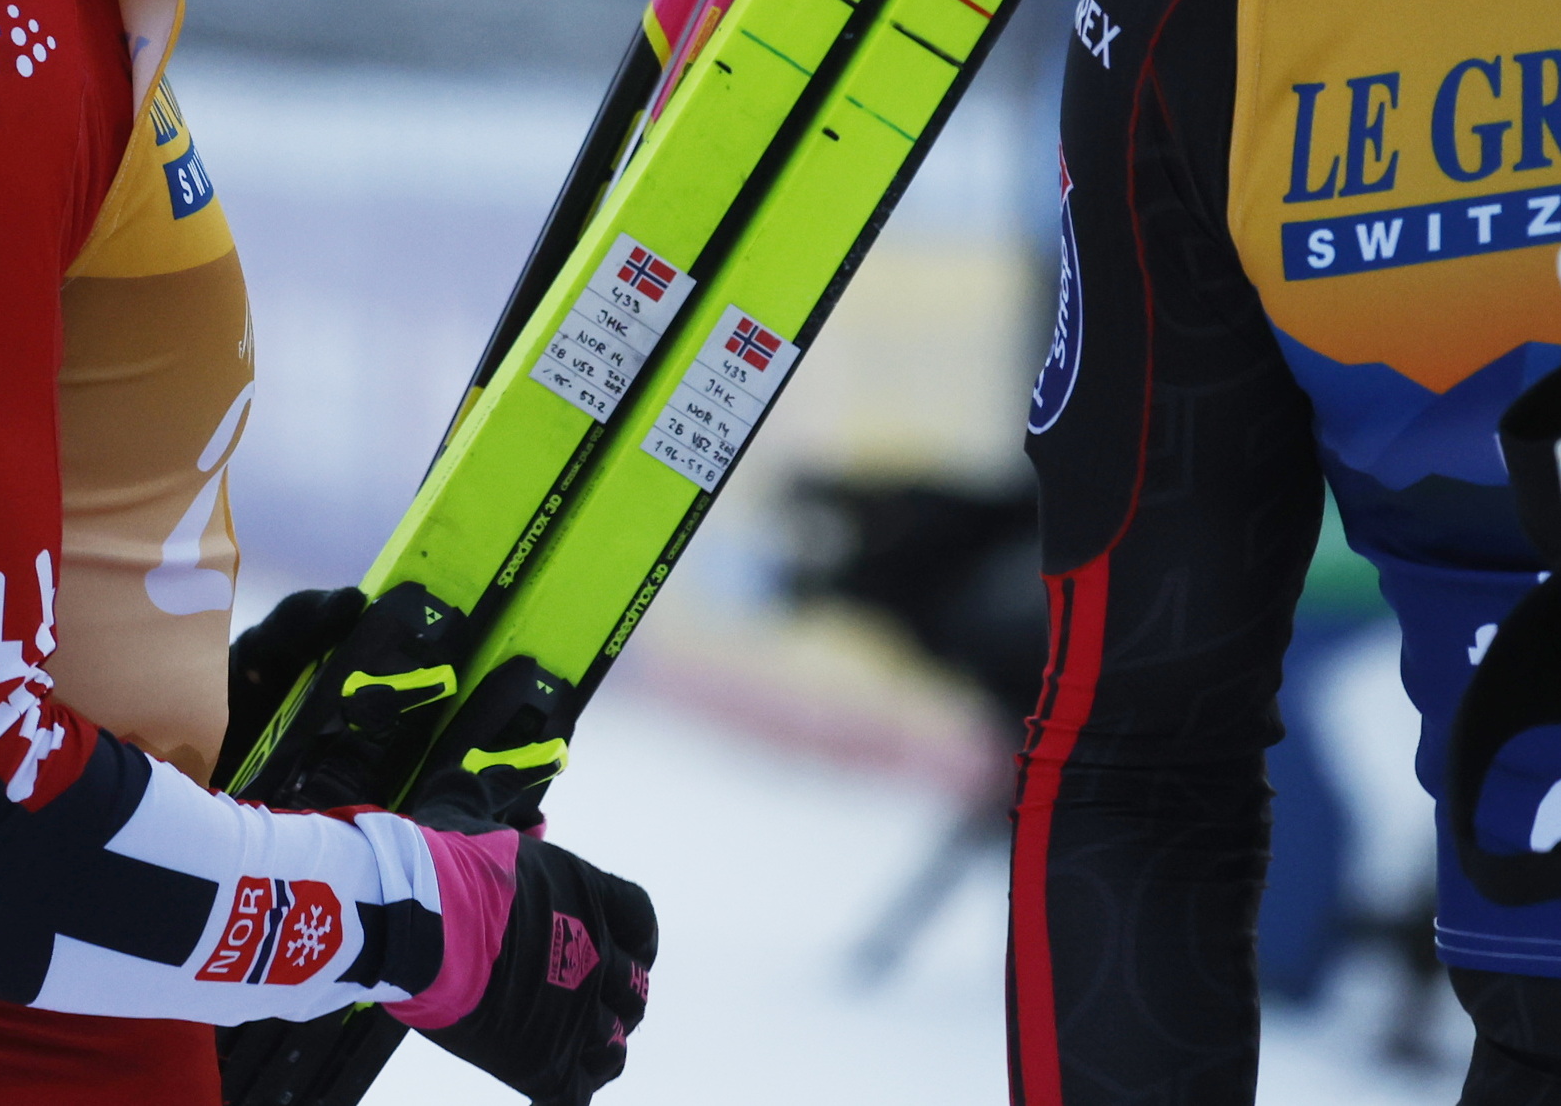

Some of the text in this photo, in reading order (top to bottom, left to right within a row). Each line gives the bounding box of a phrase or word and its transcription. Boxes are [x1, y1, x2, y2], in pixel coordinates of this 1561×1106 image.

[1282, 71, 1401, 204] LE
[1307, 194, 1561, 270] SWITZ
[577, 330, 607, 355] NOR
[597, 309, 629, 337] JHK
[686, 402, 714, 425] NOR
[704, 378, 735, 407] JHK
[497, 513, 551, 588] speedmax
[544, 494, 562, 514] 3D
[605, 581, 659, 657] speedmax
[652, 563, 668, 583] 3D
[206, 887, 264, 974] NOR
